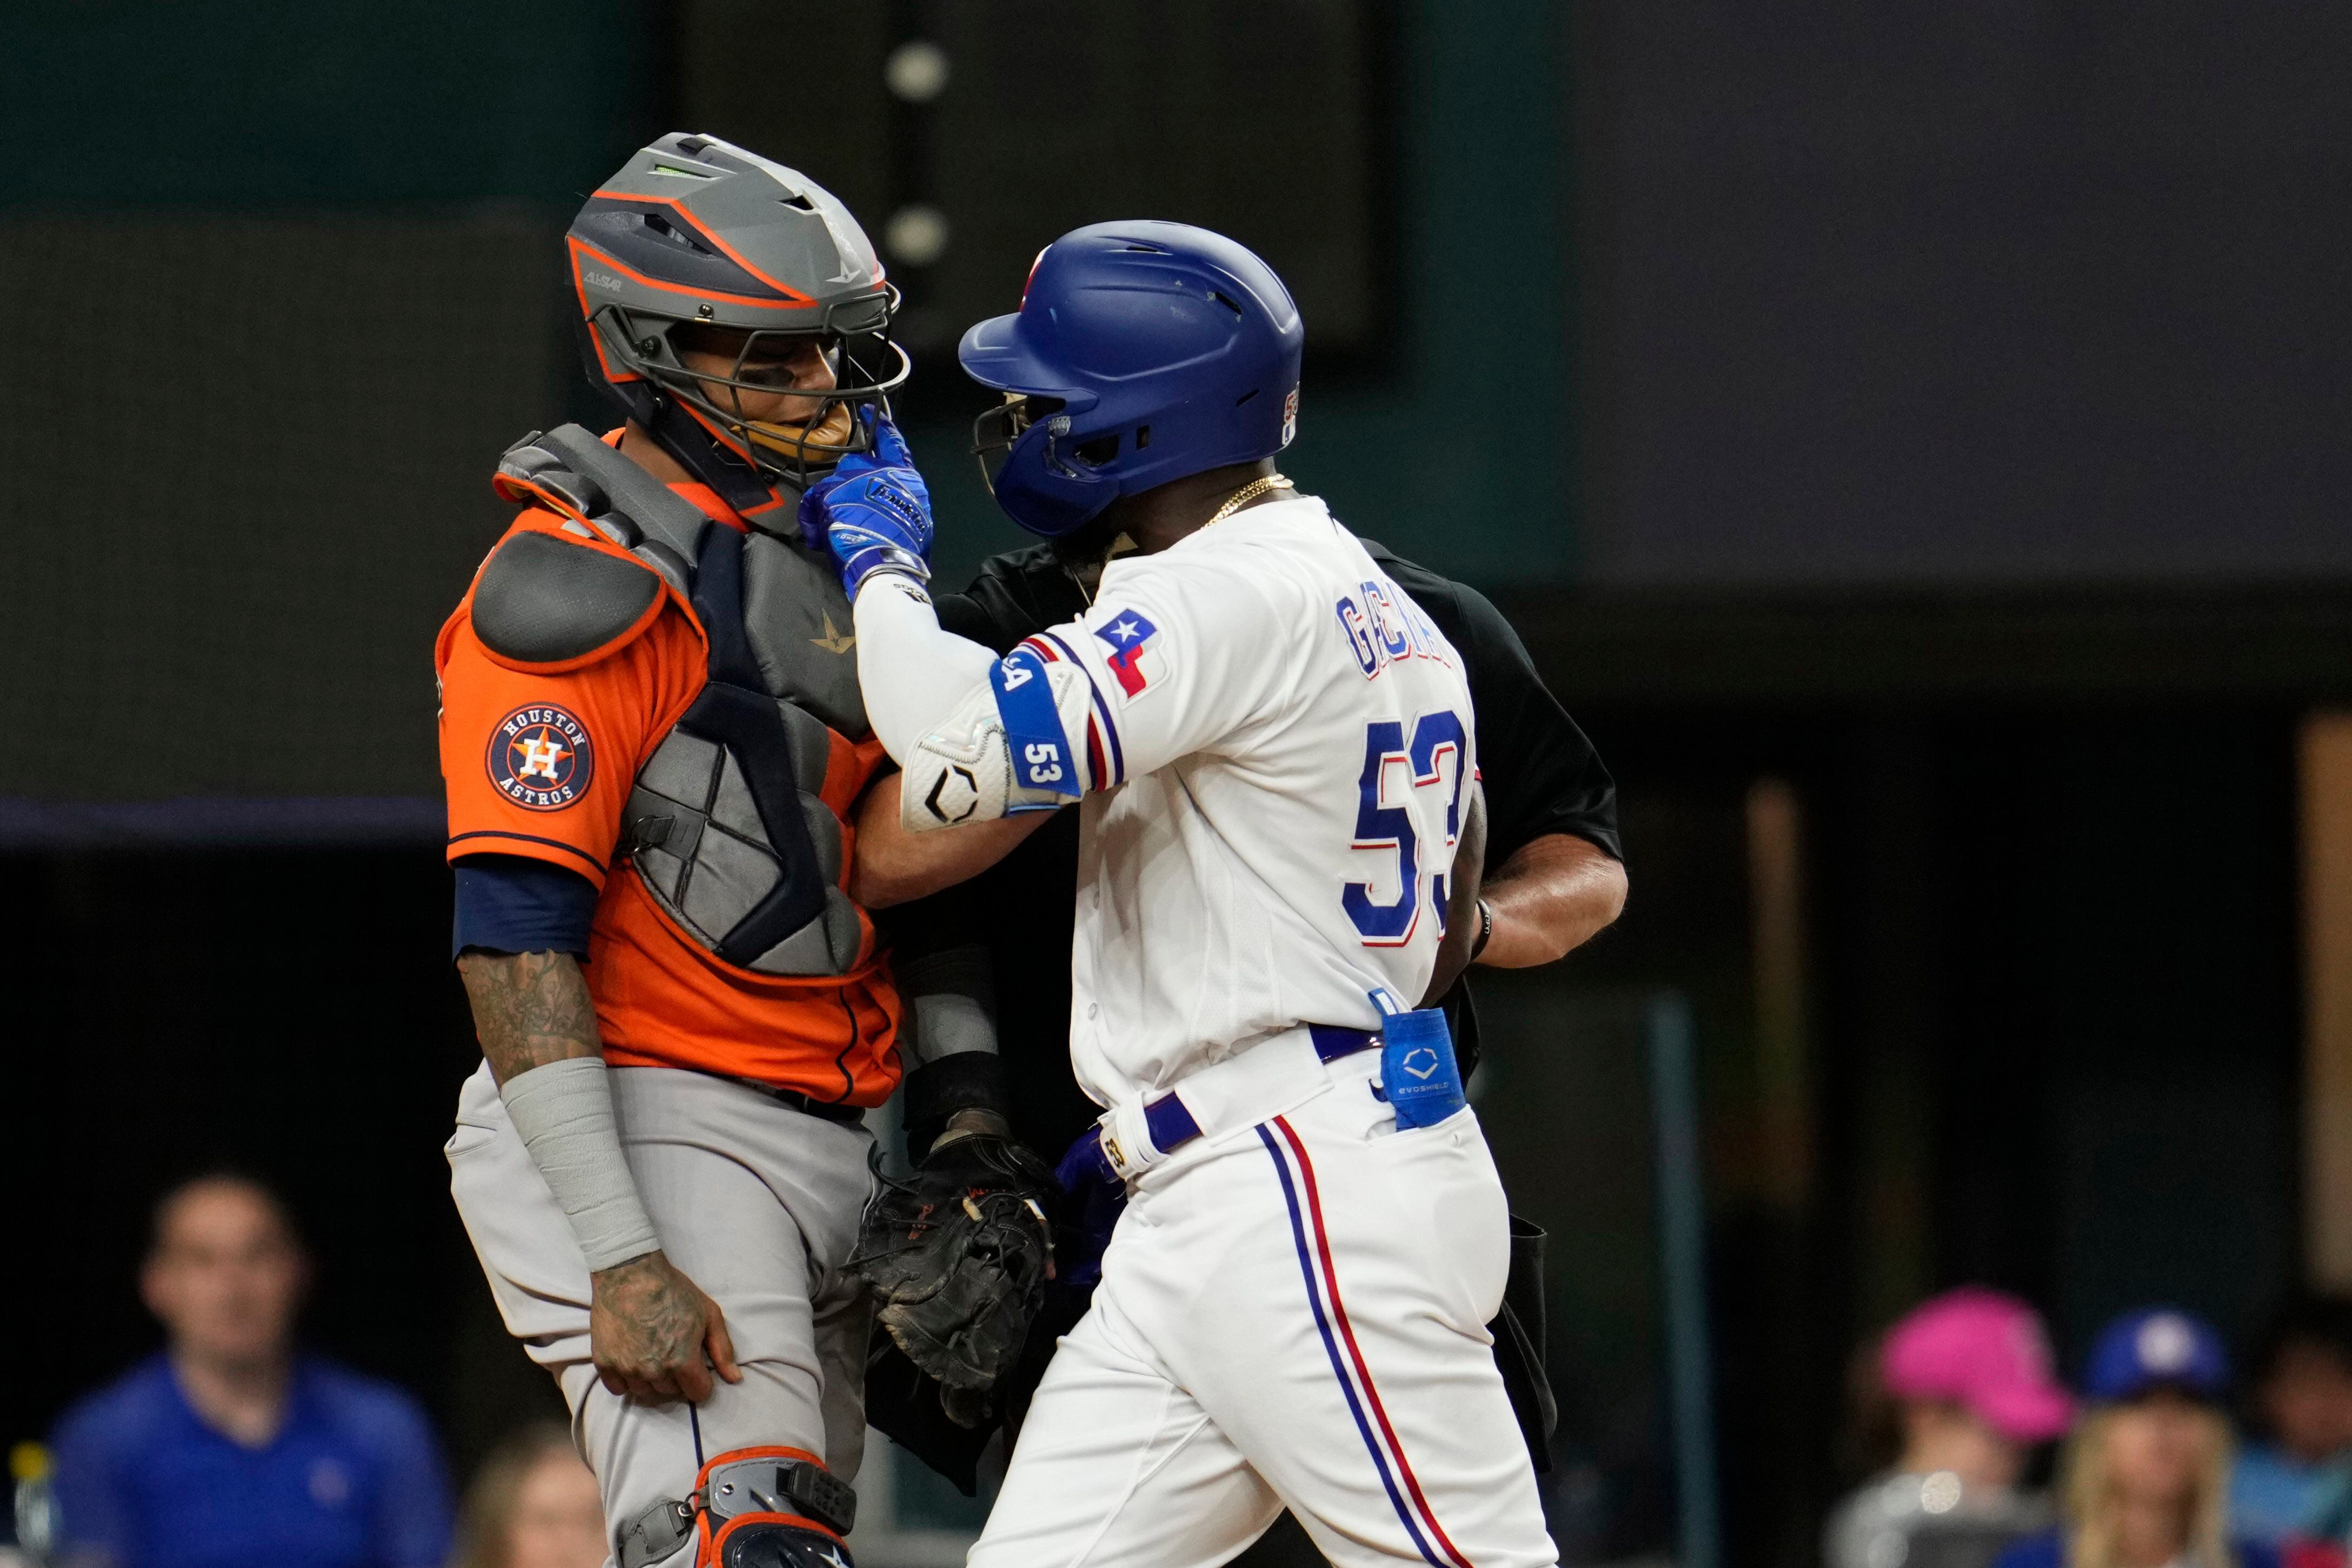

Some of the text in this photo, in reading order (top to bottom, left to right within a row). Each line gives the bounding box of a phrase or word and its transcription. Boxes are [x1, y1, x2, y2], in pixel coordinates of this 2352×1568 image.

[503, 709, 586, 747] HOUSTON
[519, 738, 563, 779] H
[1025, 743, 1062, 783] 53
[499, 777, 574, 806] ASTROS
[1337, 709, 1470, 948] 53
